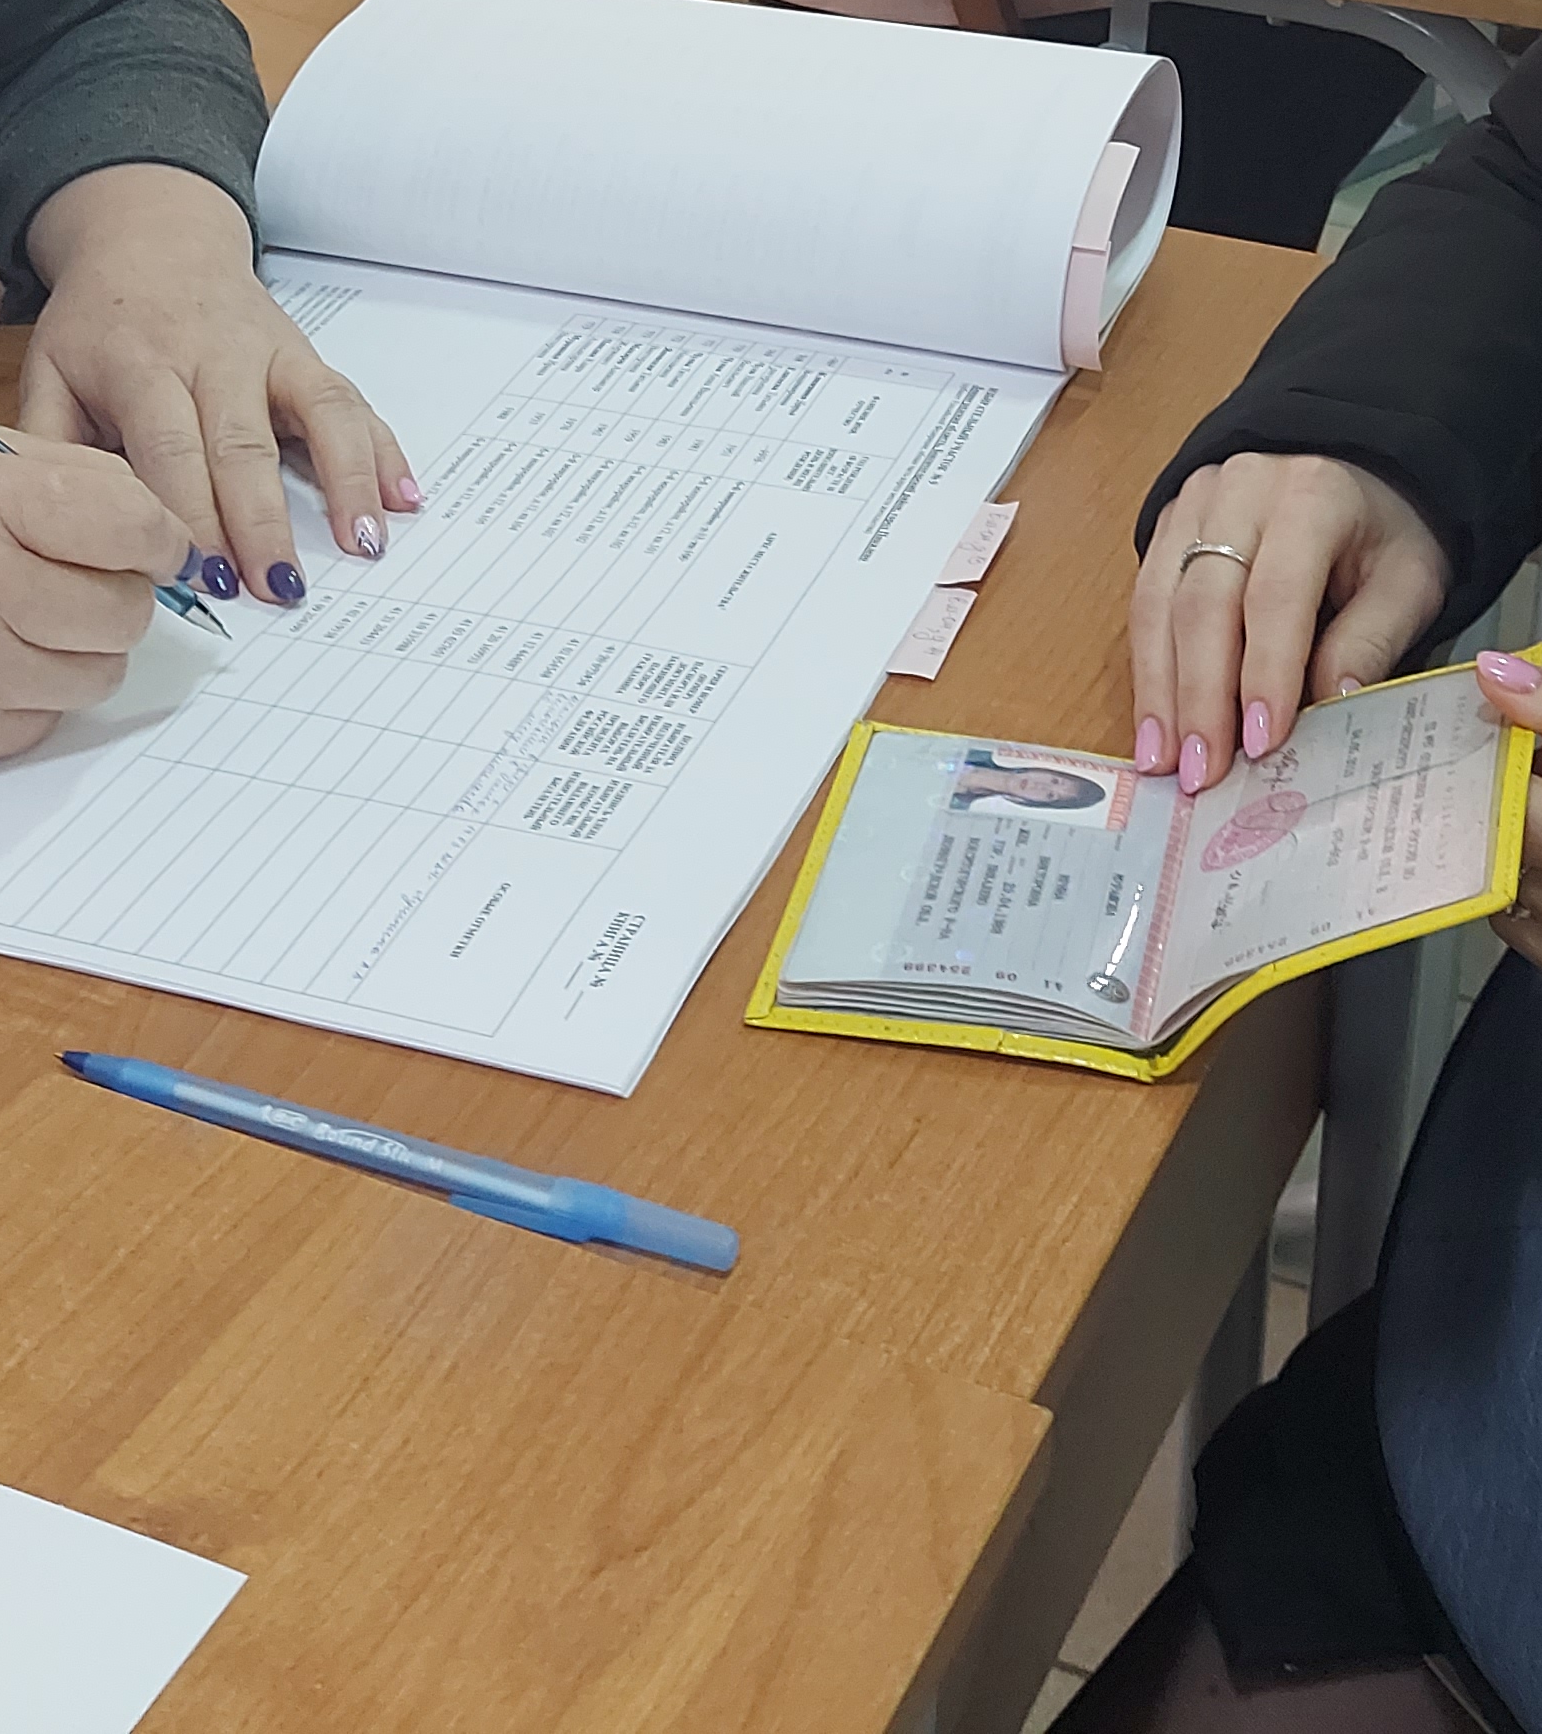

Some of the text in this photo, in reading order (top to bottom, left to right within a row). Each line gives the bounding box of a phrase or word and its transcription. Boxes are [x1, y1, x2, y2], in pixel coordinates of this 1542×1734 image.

[447, 882, 512, 958] ОСОБЫЕ ОТМЕТКИ
[594, 911, 630, 948] КНИГА
[596, 913, 647, 974] СТРАНИЦА
